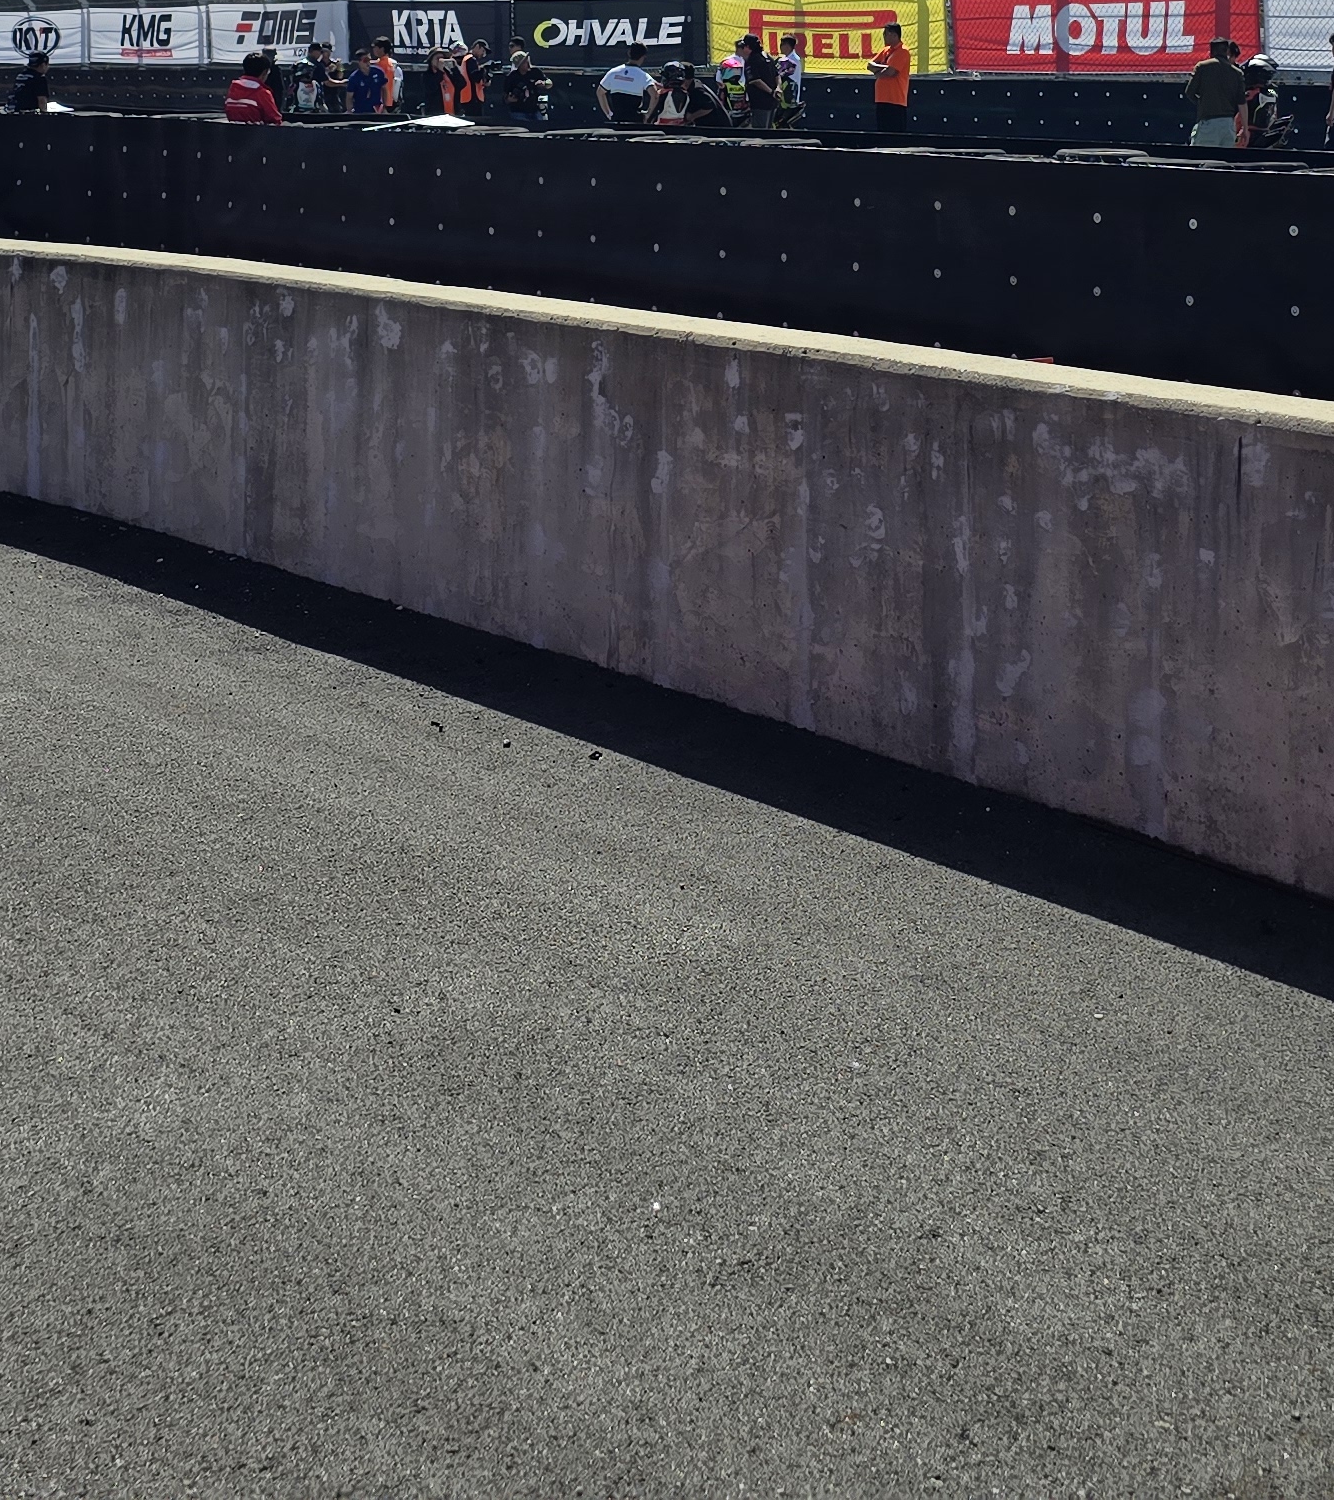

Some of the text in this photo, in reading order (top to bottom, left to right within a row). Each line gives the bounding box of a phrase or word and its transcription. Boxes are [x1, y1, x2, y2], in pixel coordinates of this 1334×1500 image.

[120, 14, 172, 47] KMG
[235, 9, 317, 45] FOMS
[391, 9, 465, 48] KRTA
[533, 16, 686, 48] OHVALE
[749, 9, 898, 59] PIRELL
[1006, 0, 1195, 56] MOTUL
